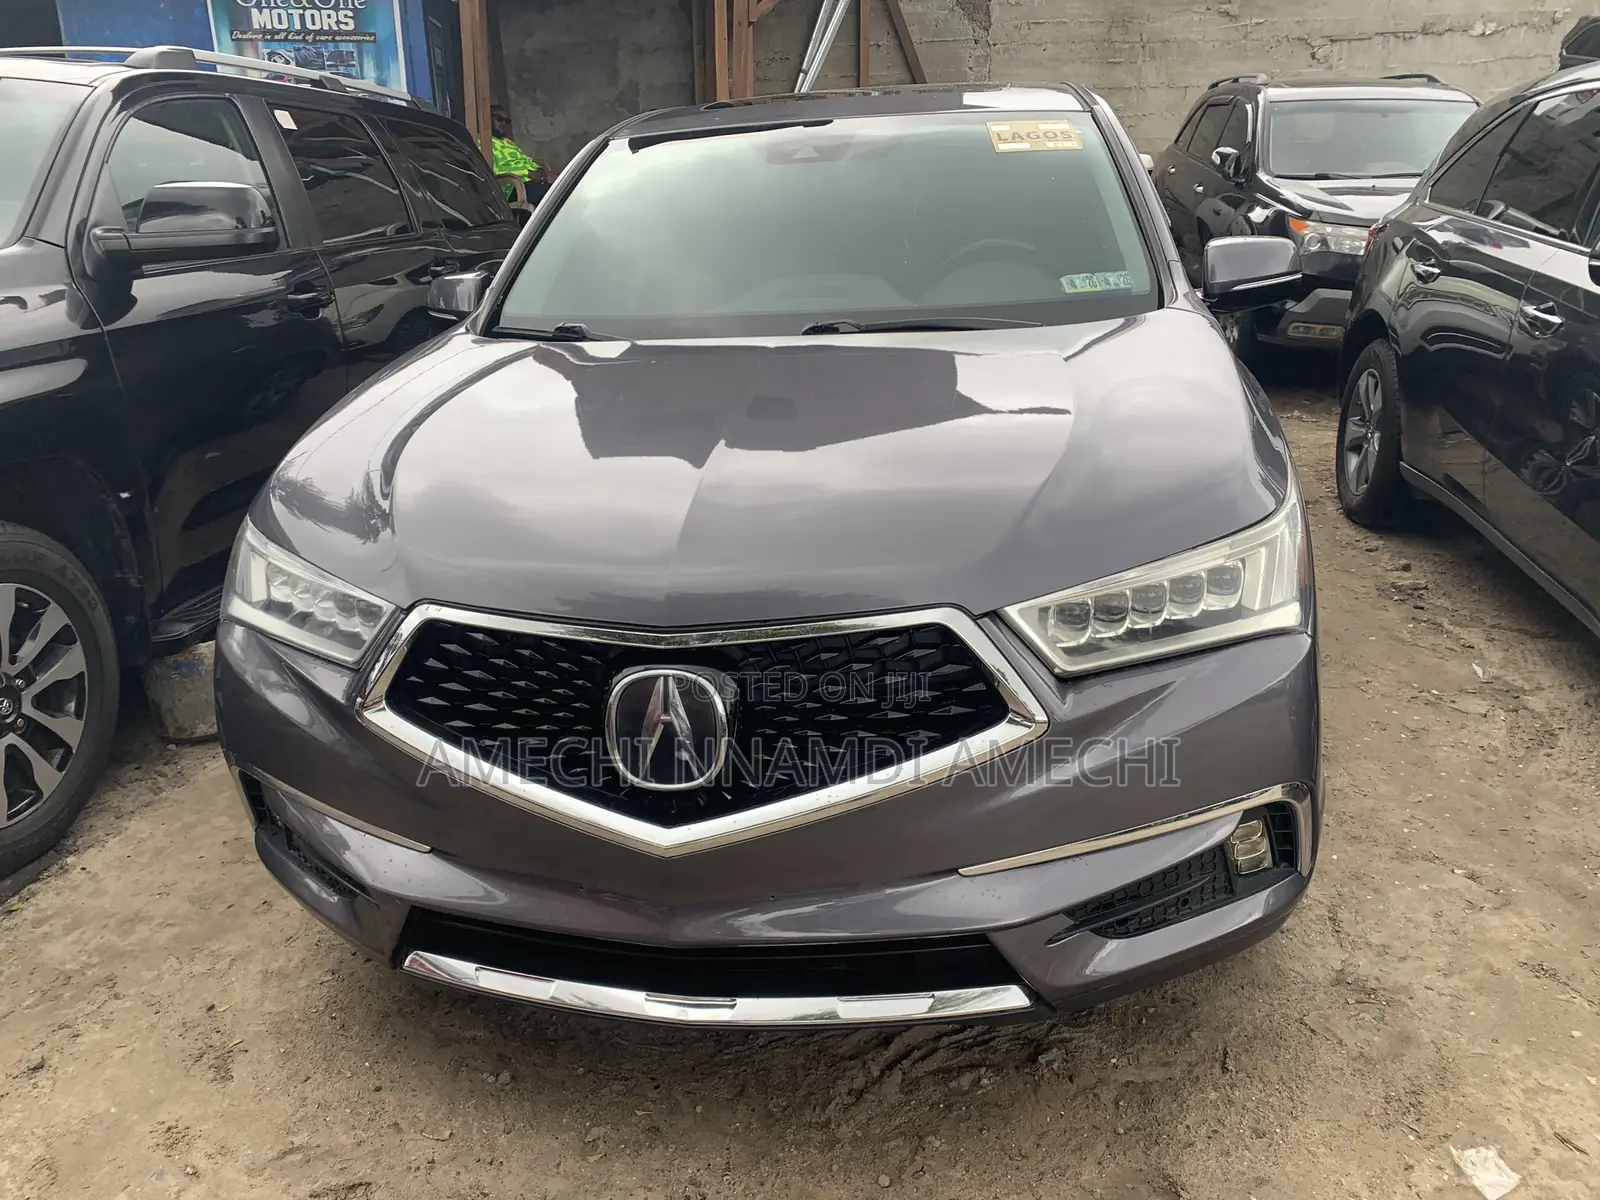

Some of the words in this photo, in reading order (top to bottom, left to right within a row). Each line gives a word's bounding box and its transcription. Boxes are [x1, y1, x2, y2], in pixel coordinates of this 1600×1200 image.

[250, 8, 356, 31] MOTORS
[231, 30, 263, 40] Dealers
[273, 31, 287, 40] all
[305, 32, 315, 43] of
[995, 130, 1073, 141] LAGOS
